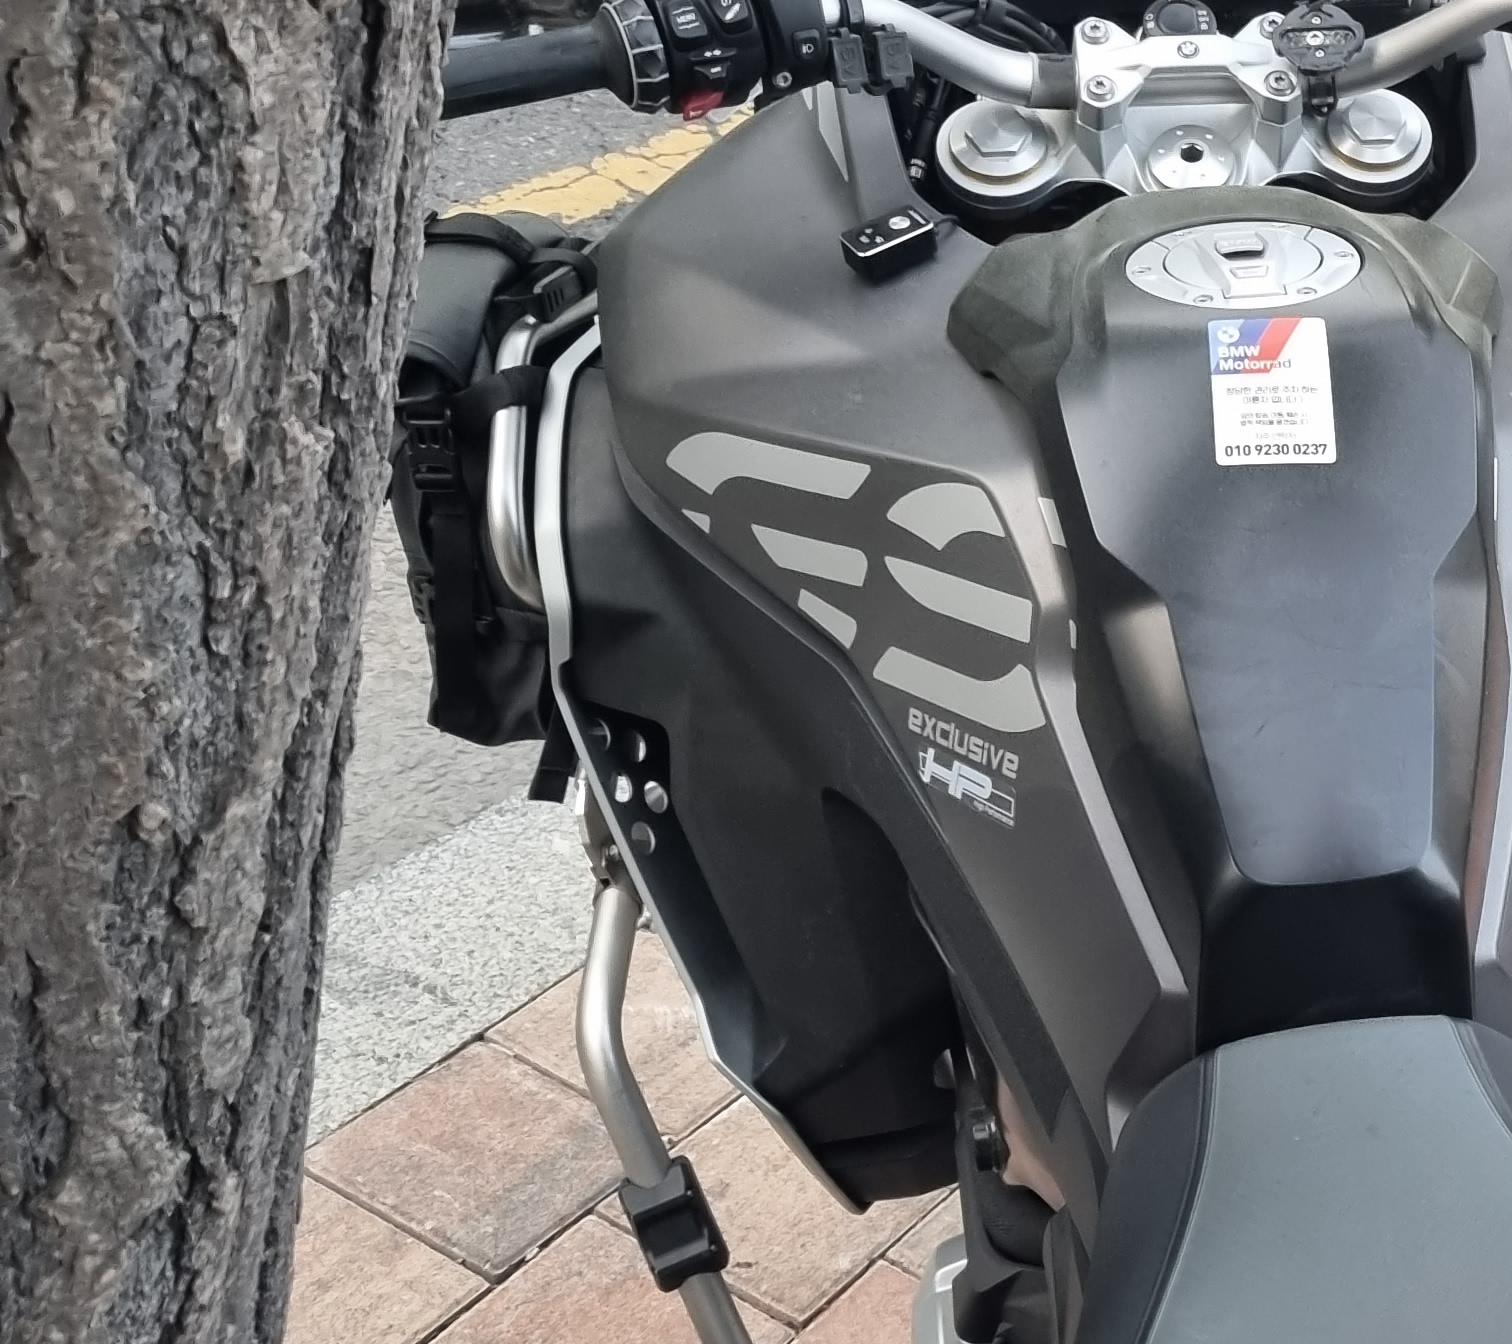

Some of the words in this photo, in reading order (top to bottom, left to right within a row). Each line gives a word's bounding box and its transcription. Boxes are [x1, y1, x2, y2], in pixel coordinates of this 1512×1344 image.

[1217, 345, 1260, 358] BMW
[1219, 358, 1292, 371] Motorrad
[1225, 444, 1251, 457] 010
[1254, 443, 1289, 456] 9230
[1292, 443, 1327, 455] 0237
[908, 707, 1019, 779] exclusive
